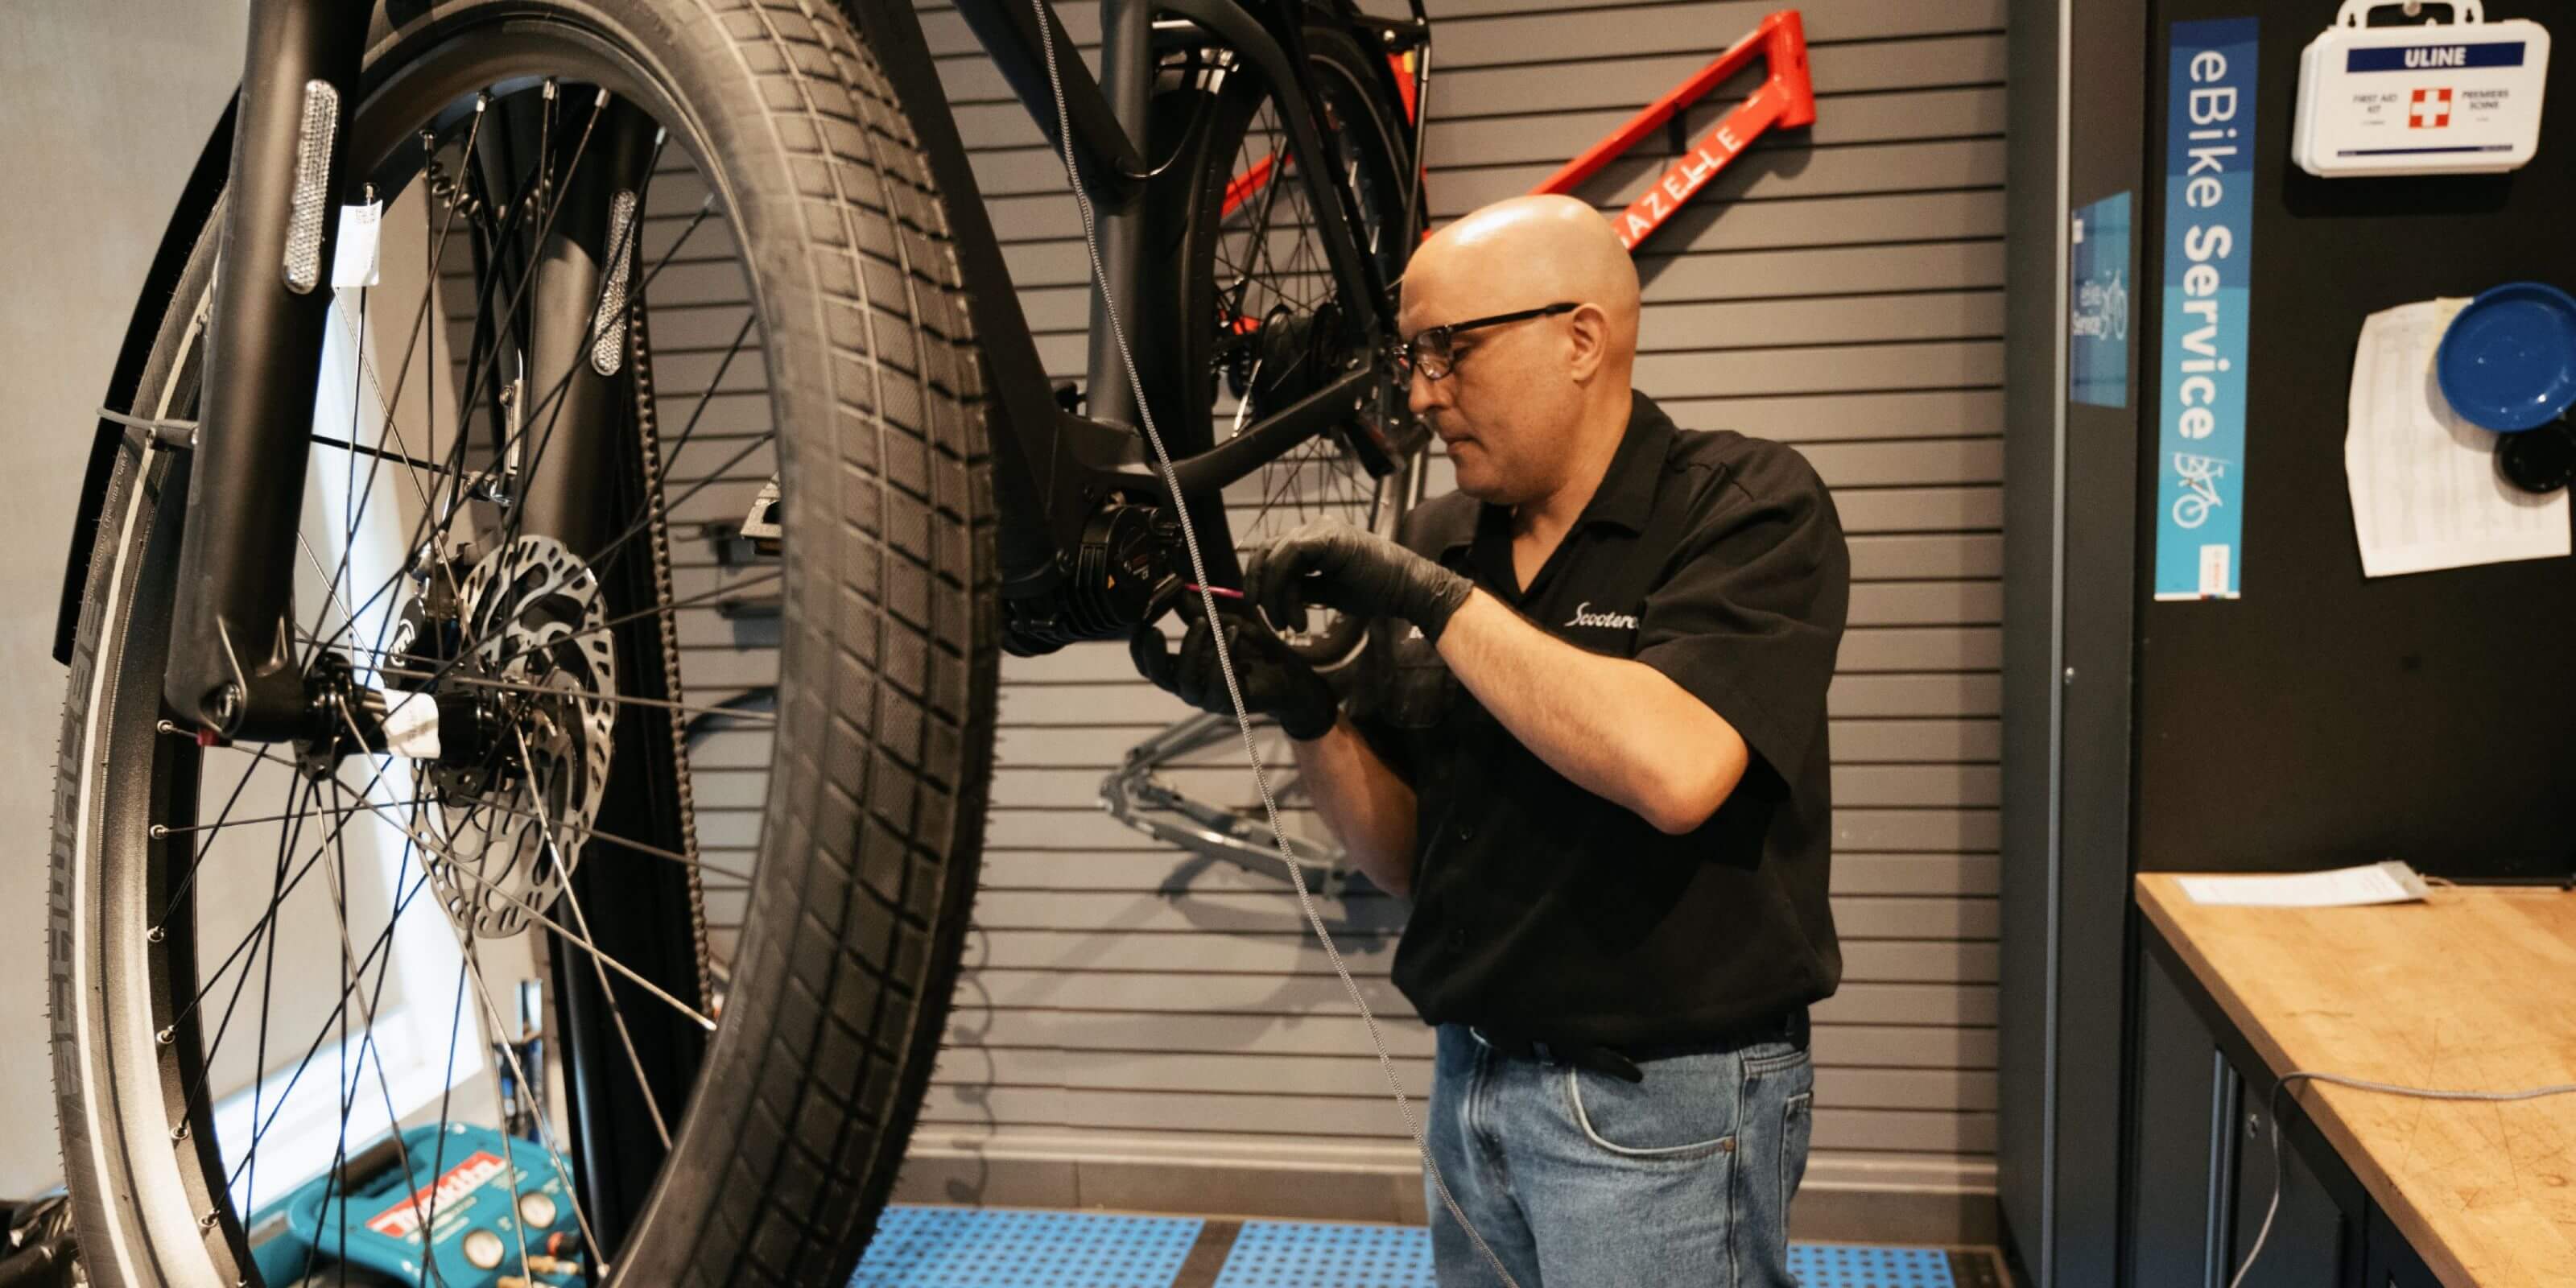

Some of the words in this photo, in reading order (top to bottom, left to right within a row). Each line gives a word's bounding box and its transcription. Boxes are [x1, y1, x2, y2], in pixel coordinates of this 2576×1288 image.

[2186, 50, 2238, 208] eBike
[2404, 46, 2467, 68] ULINE
[2178, 225, 2233, 440] Service
[49, 601, 101, 1096] SCHWALBE
